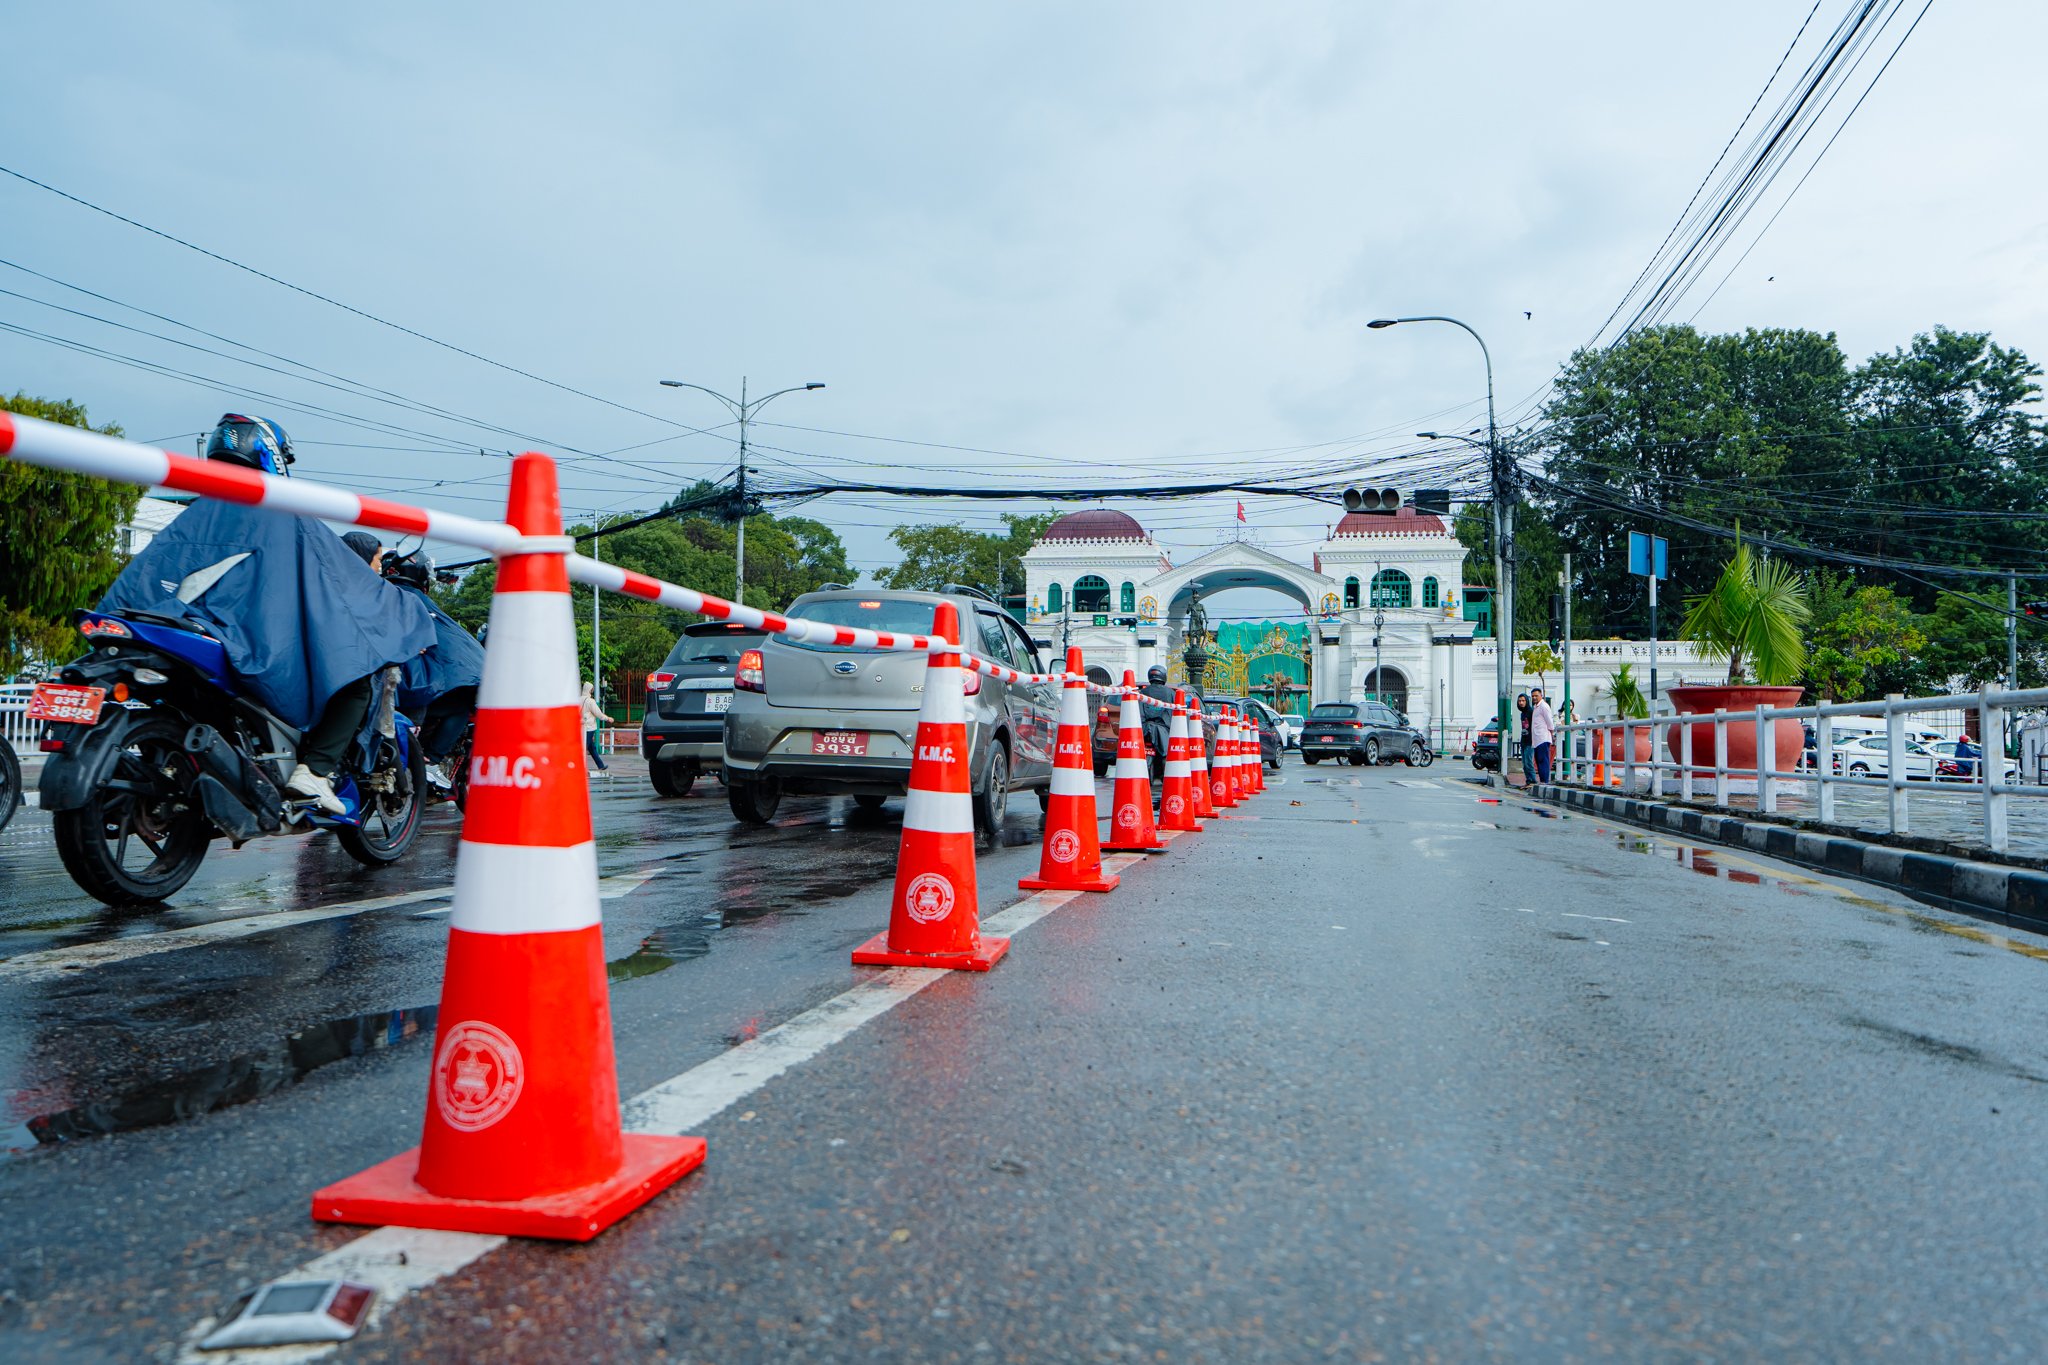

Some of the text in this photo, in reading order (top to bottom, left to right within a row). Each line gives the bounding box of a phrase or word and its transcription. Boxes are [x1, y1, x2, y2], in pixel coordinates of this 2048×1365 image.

[262, 436, 287, 476] SPOR
[1059, 743, 1084, 755] K.M.C.
[1120, 741, 1140, 750] K.M.C.
[918, 745, 956, 763] K.M.C.
